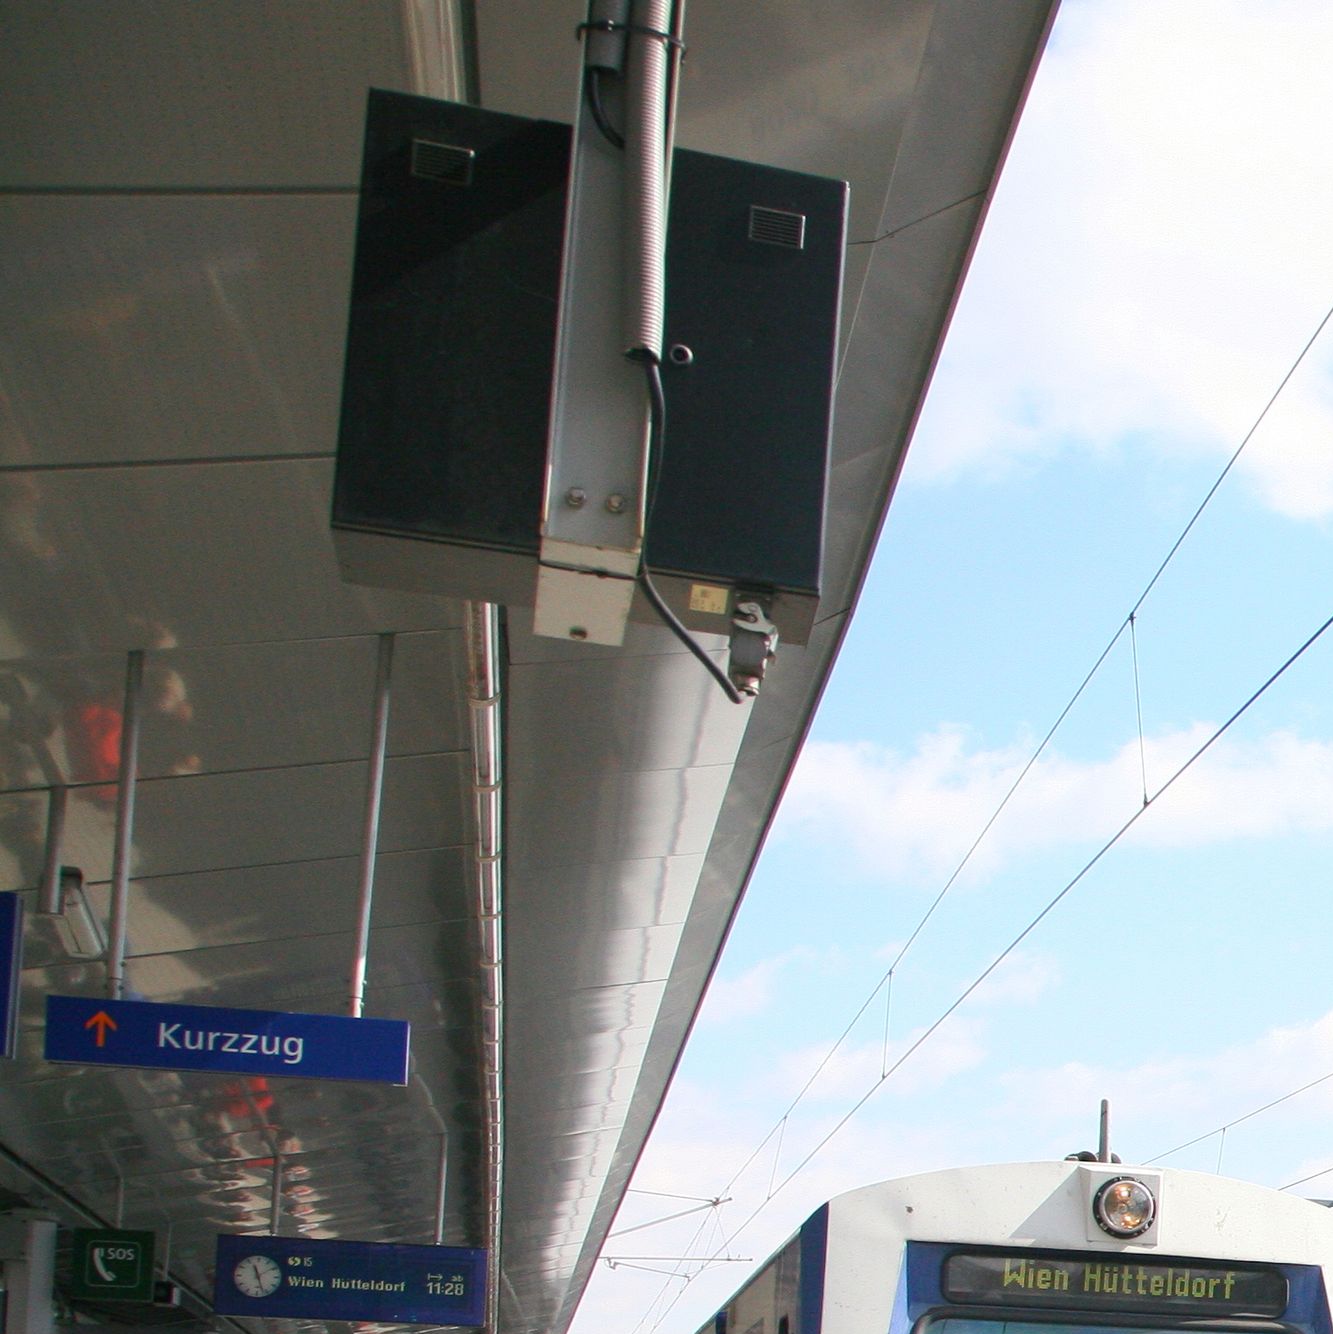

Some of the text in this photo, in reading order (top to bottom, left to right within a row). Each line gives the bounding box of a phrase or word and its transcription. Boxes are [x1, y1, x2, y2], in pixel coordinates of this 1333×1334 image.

[158, 1022, 304, 1064] Kurzzug
[106, 1247, 135, 1260] SOS
[288, 1275, 324, 1288] Wien
[1003, 1258, 1236, 1300] Wien Hütteldorf
[426, 1282, 464, 1296] 11:28
